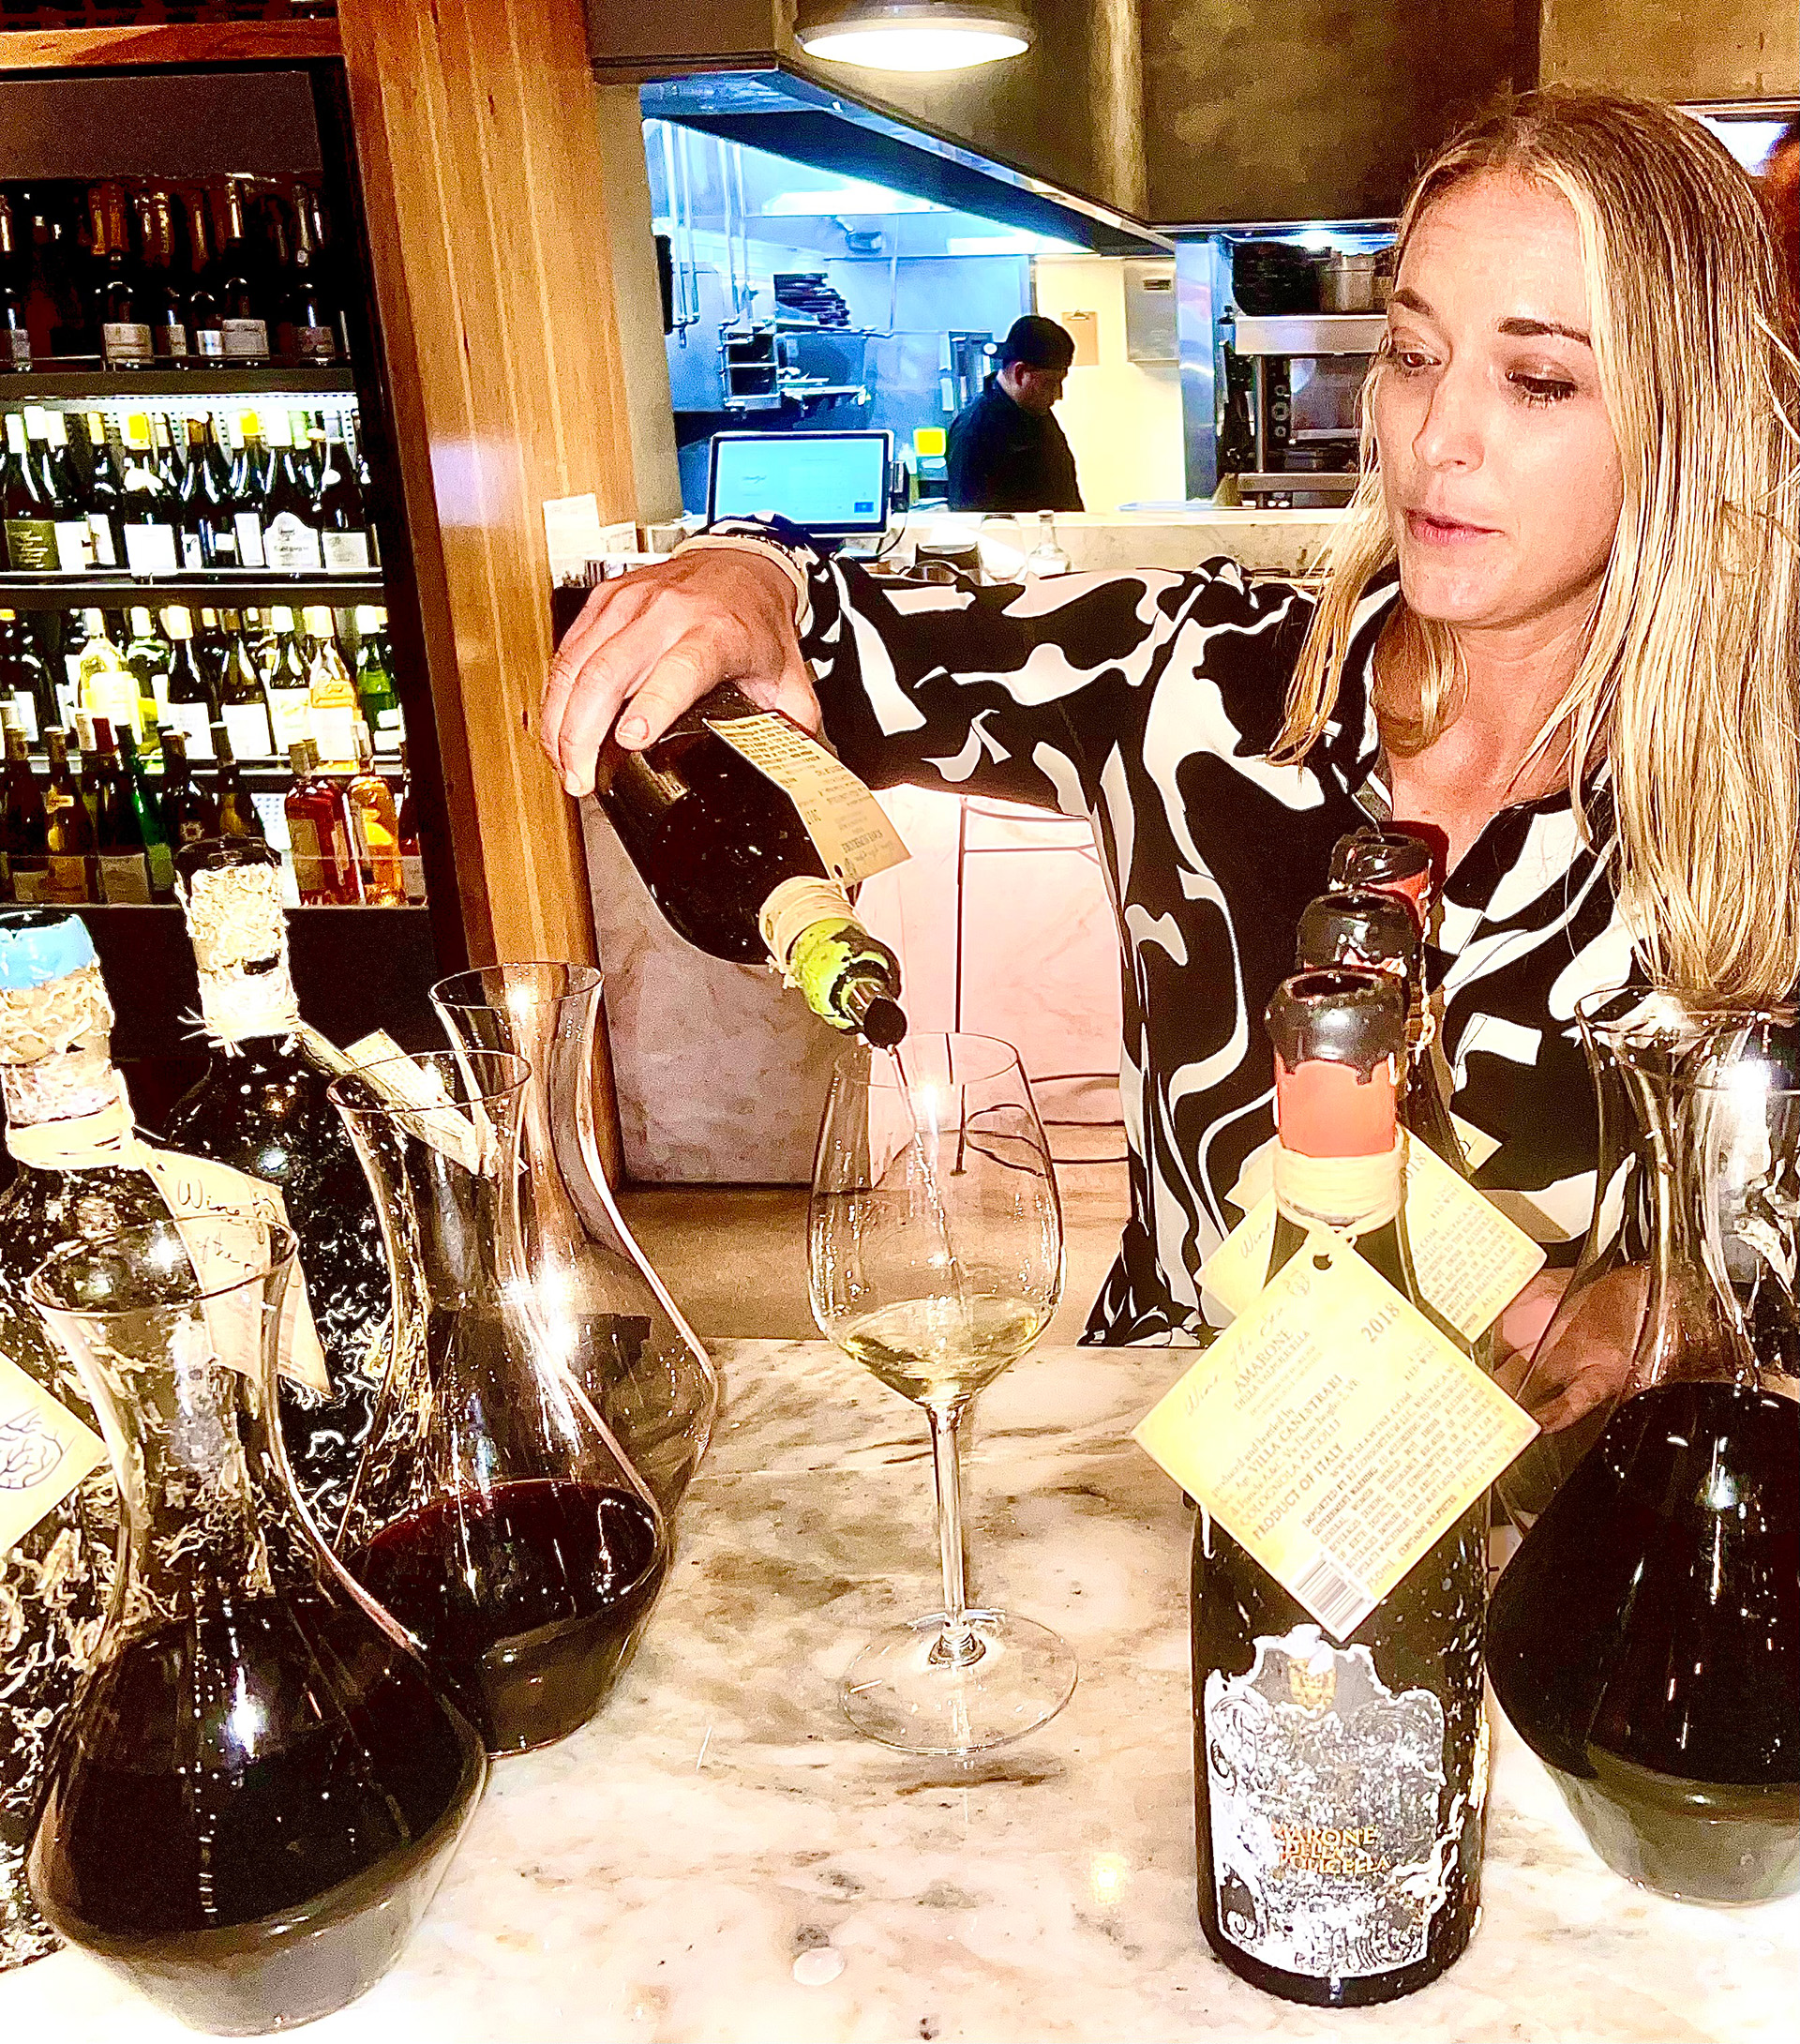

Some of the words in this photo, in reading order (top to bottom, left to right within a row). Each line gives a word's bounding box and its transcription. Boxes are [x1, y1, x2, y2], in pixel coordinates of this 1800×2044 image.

[1399, 1150, 1428, 1180] 018
[177, 1179, 240, 1216] Wine
[1358, 1300, 1402, 1344] 2018
[1229, 1326, 1295, 1393] AMARONE
[1247, 1439, 1281, 1475] VILLA
[1250, 1488, 1302, 1541] PRODUCT
[1297, 1471, 1318, 1493] OF
[1312, 1442, 1344, 1476] ITALY
[1364, 1557, 1395, 1590] 750ml
[1271, 1824, 1378, 1846] MARONE
